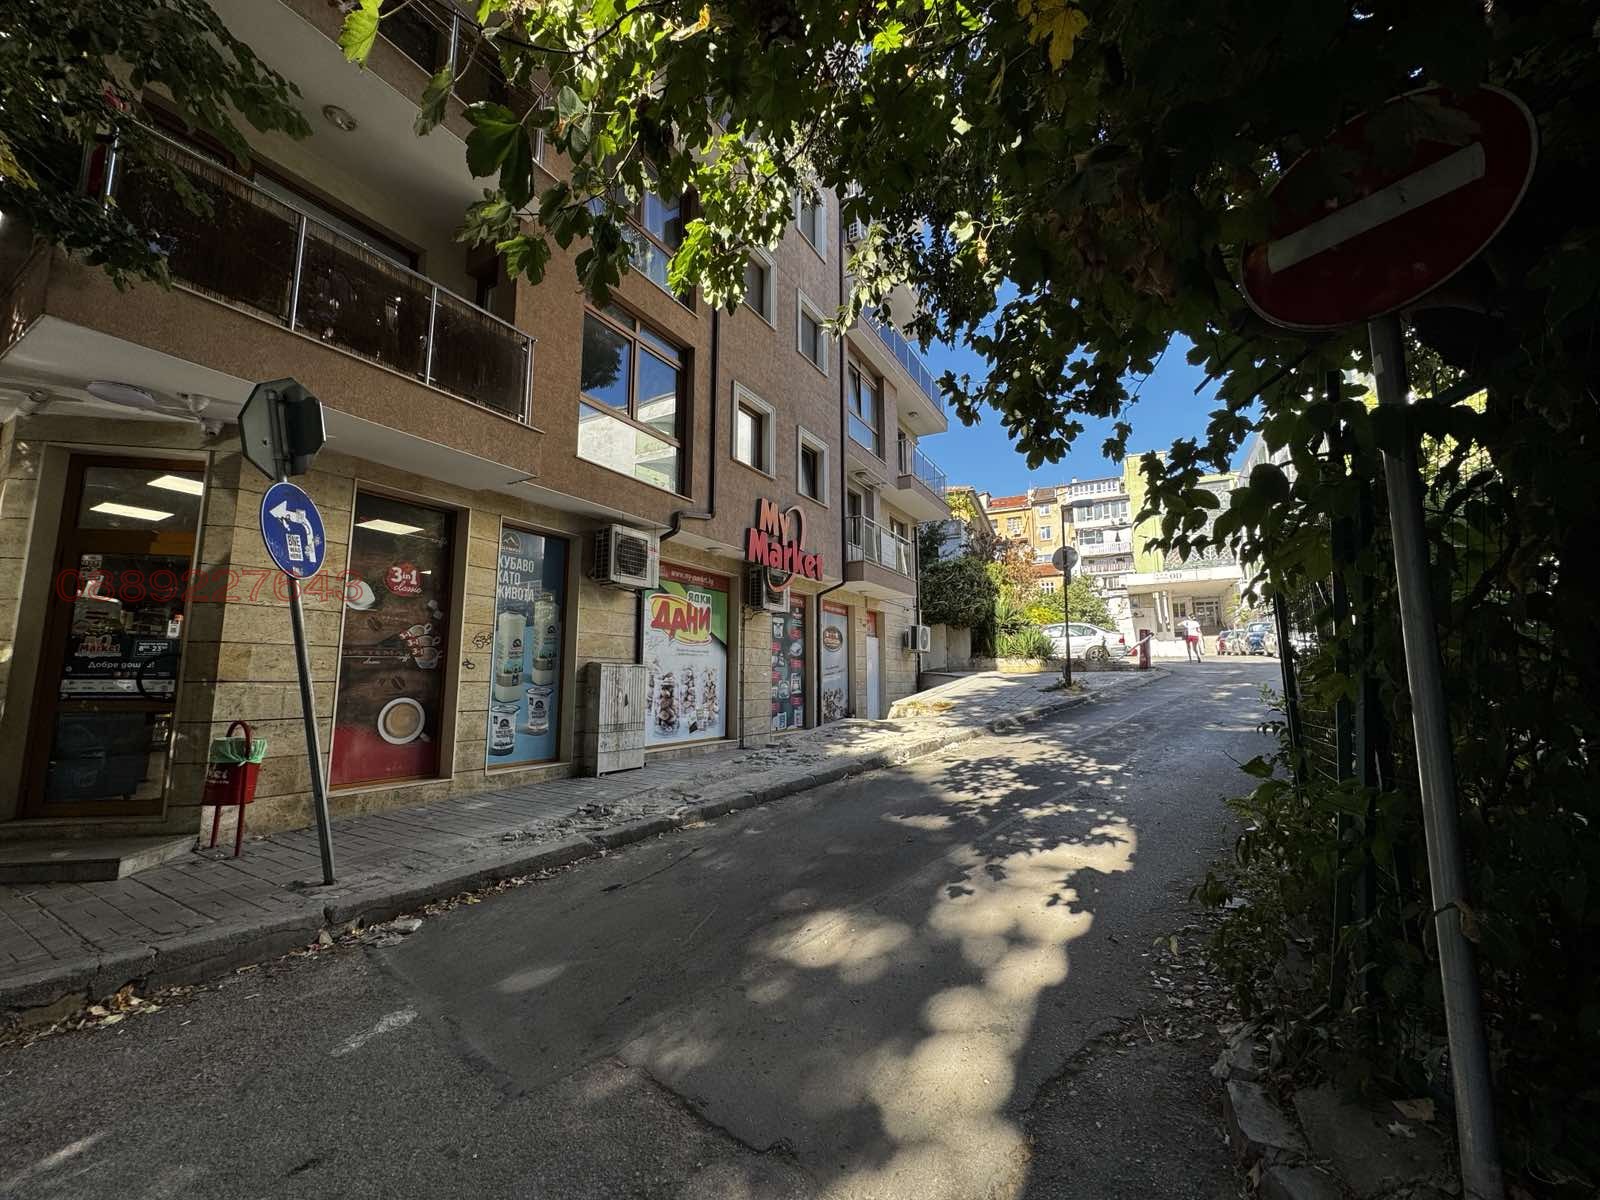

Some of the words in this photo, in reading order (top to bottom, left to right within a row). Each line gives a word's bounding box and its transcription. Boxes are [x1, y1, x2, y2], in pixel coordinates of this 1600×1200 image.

[758, 497, 791, 546] My
[747, 528, 824, 581] Market
[650, 600, 712, 635] ДАНИ
[88, 661, 119, 671] Добре
